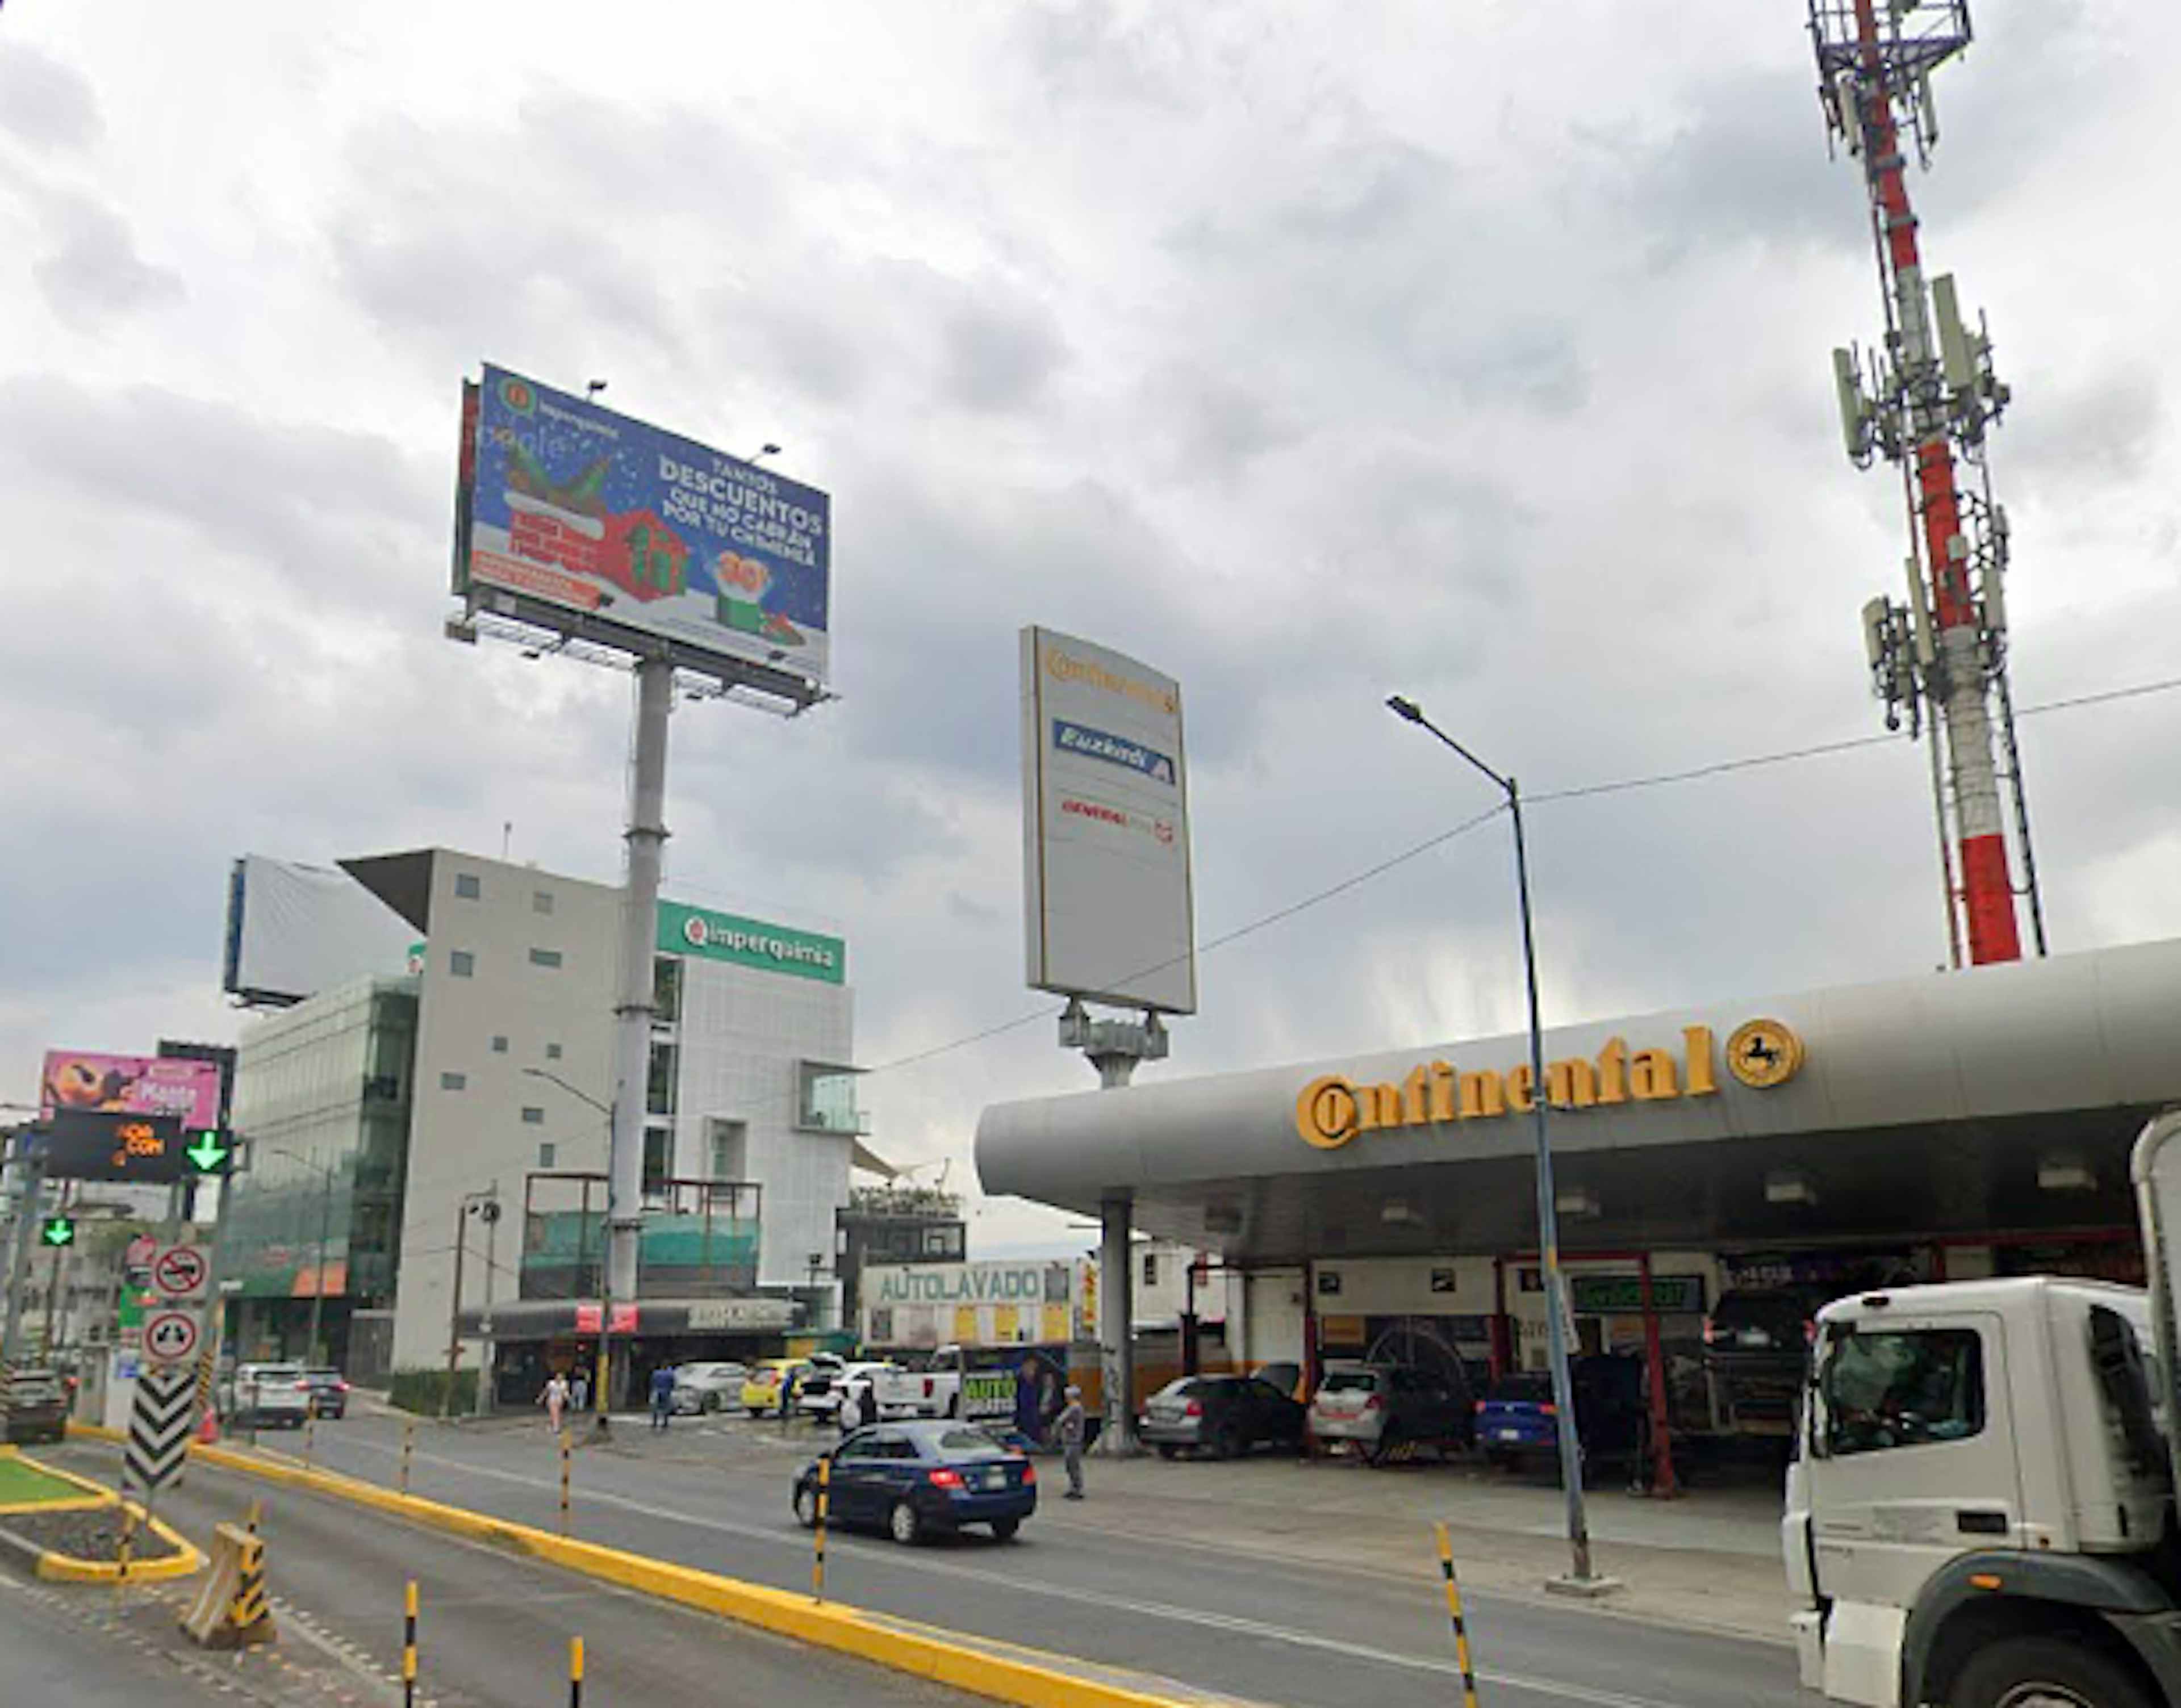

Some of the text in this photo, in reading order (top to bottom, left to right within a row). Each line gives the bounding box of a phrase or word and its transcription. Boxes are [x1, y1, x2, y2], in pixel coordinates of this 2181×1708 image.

[659, 455, 822, 535] DESCUENTOS
[670, 486, 708, 512] QUE
[712, 502, 739, 524] NO
[663, 499, 701, 528] POR
[705, 512, 729, 537] TU
[1297, 1026, 1717, 1149] Continental
[881, 1270, 1040, 1300] AUTOLAVADO
